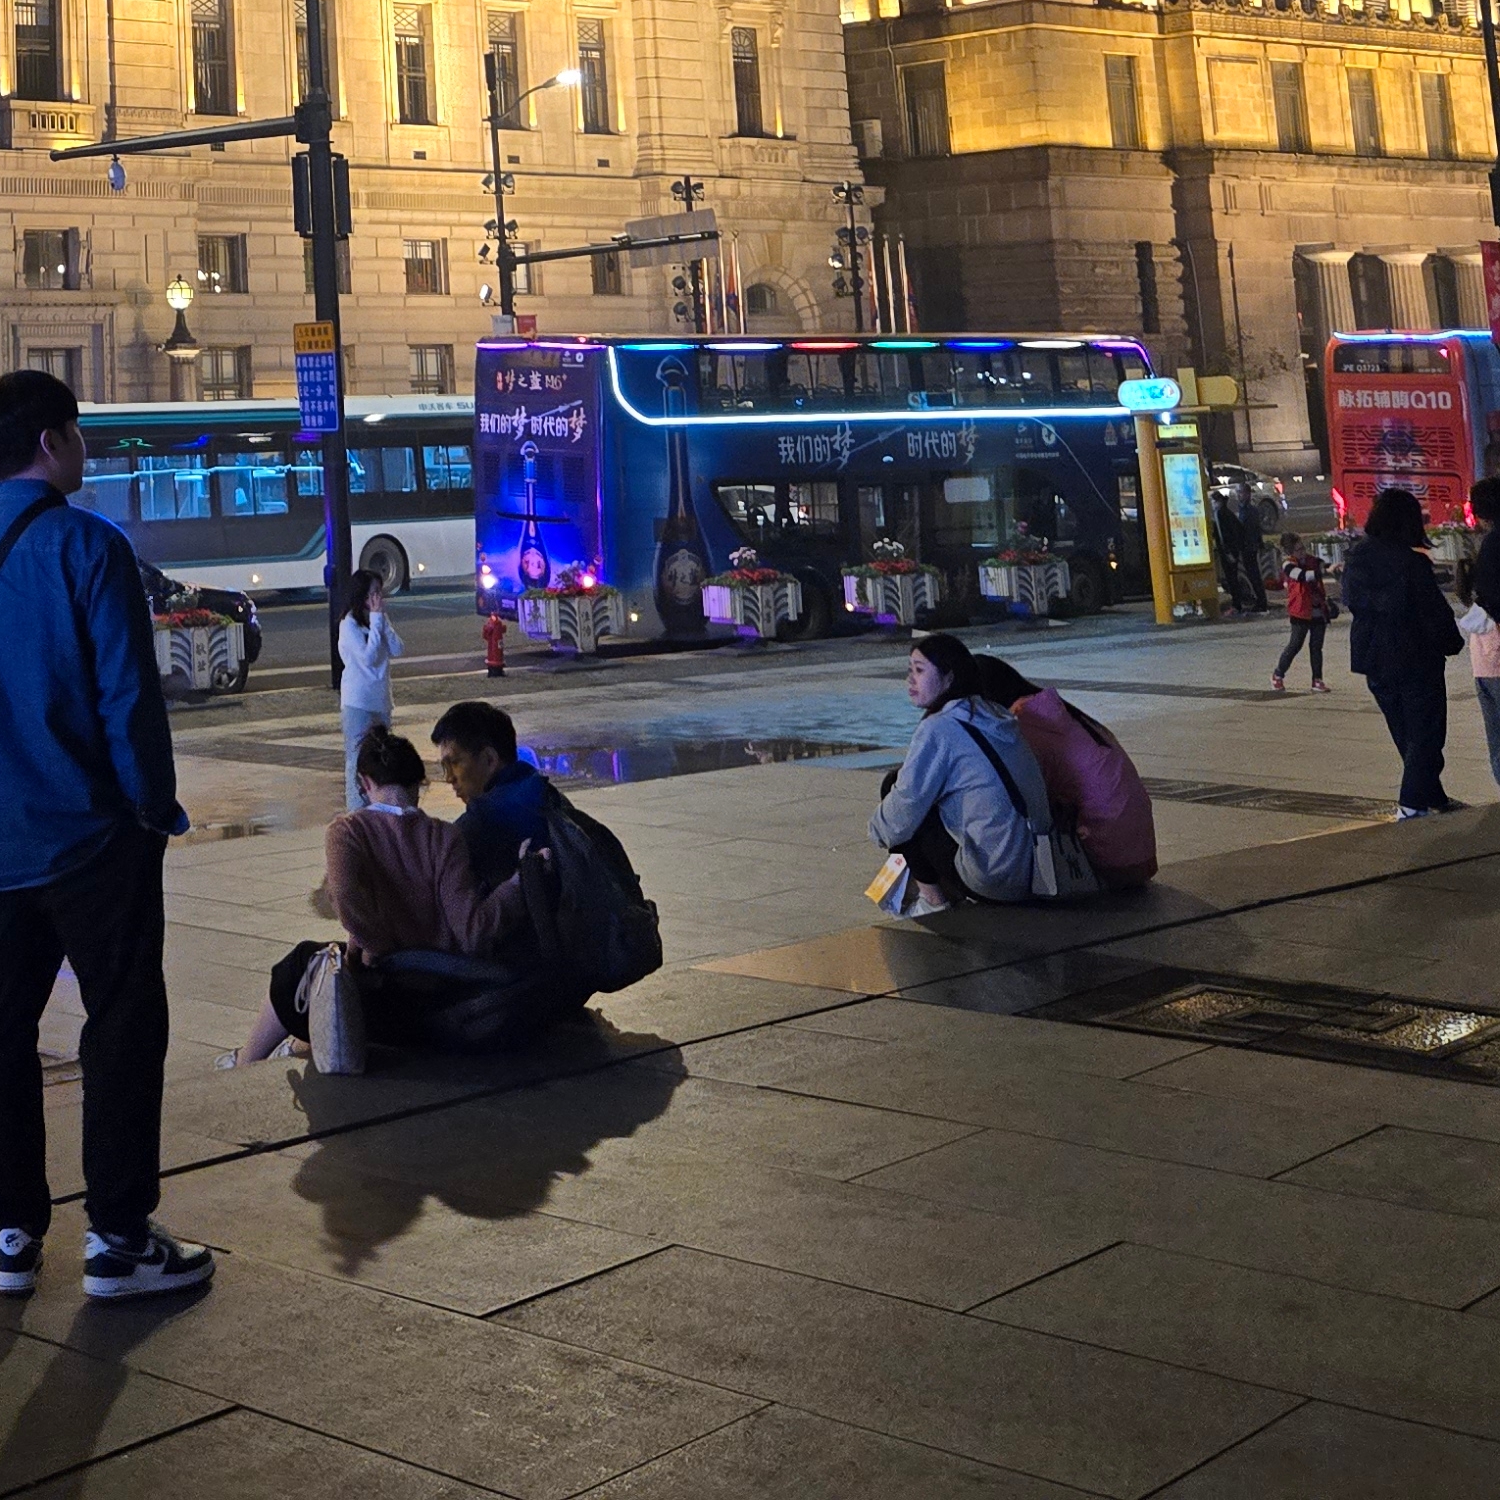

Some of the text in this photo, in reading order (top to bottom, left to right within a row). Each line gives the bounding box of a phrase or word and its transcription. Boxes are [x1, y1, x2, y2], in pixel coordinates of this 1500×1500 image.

[480, 405, 588, 443] 我们的梦 时代的梦
[778, 418, 979, 470] 我们的梦 时代的梦
